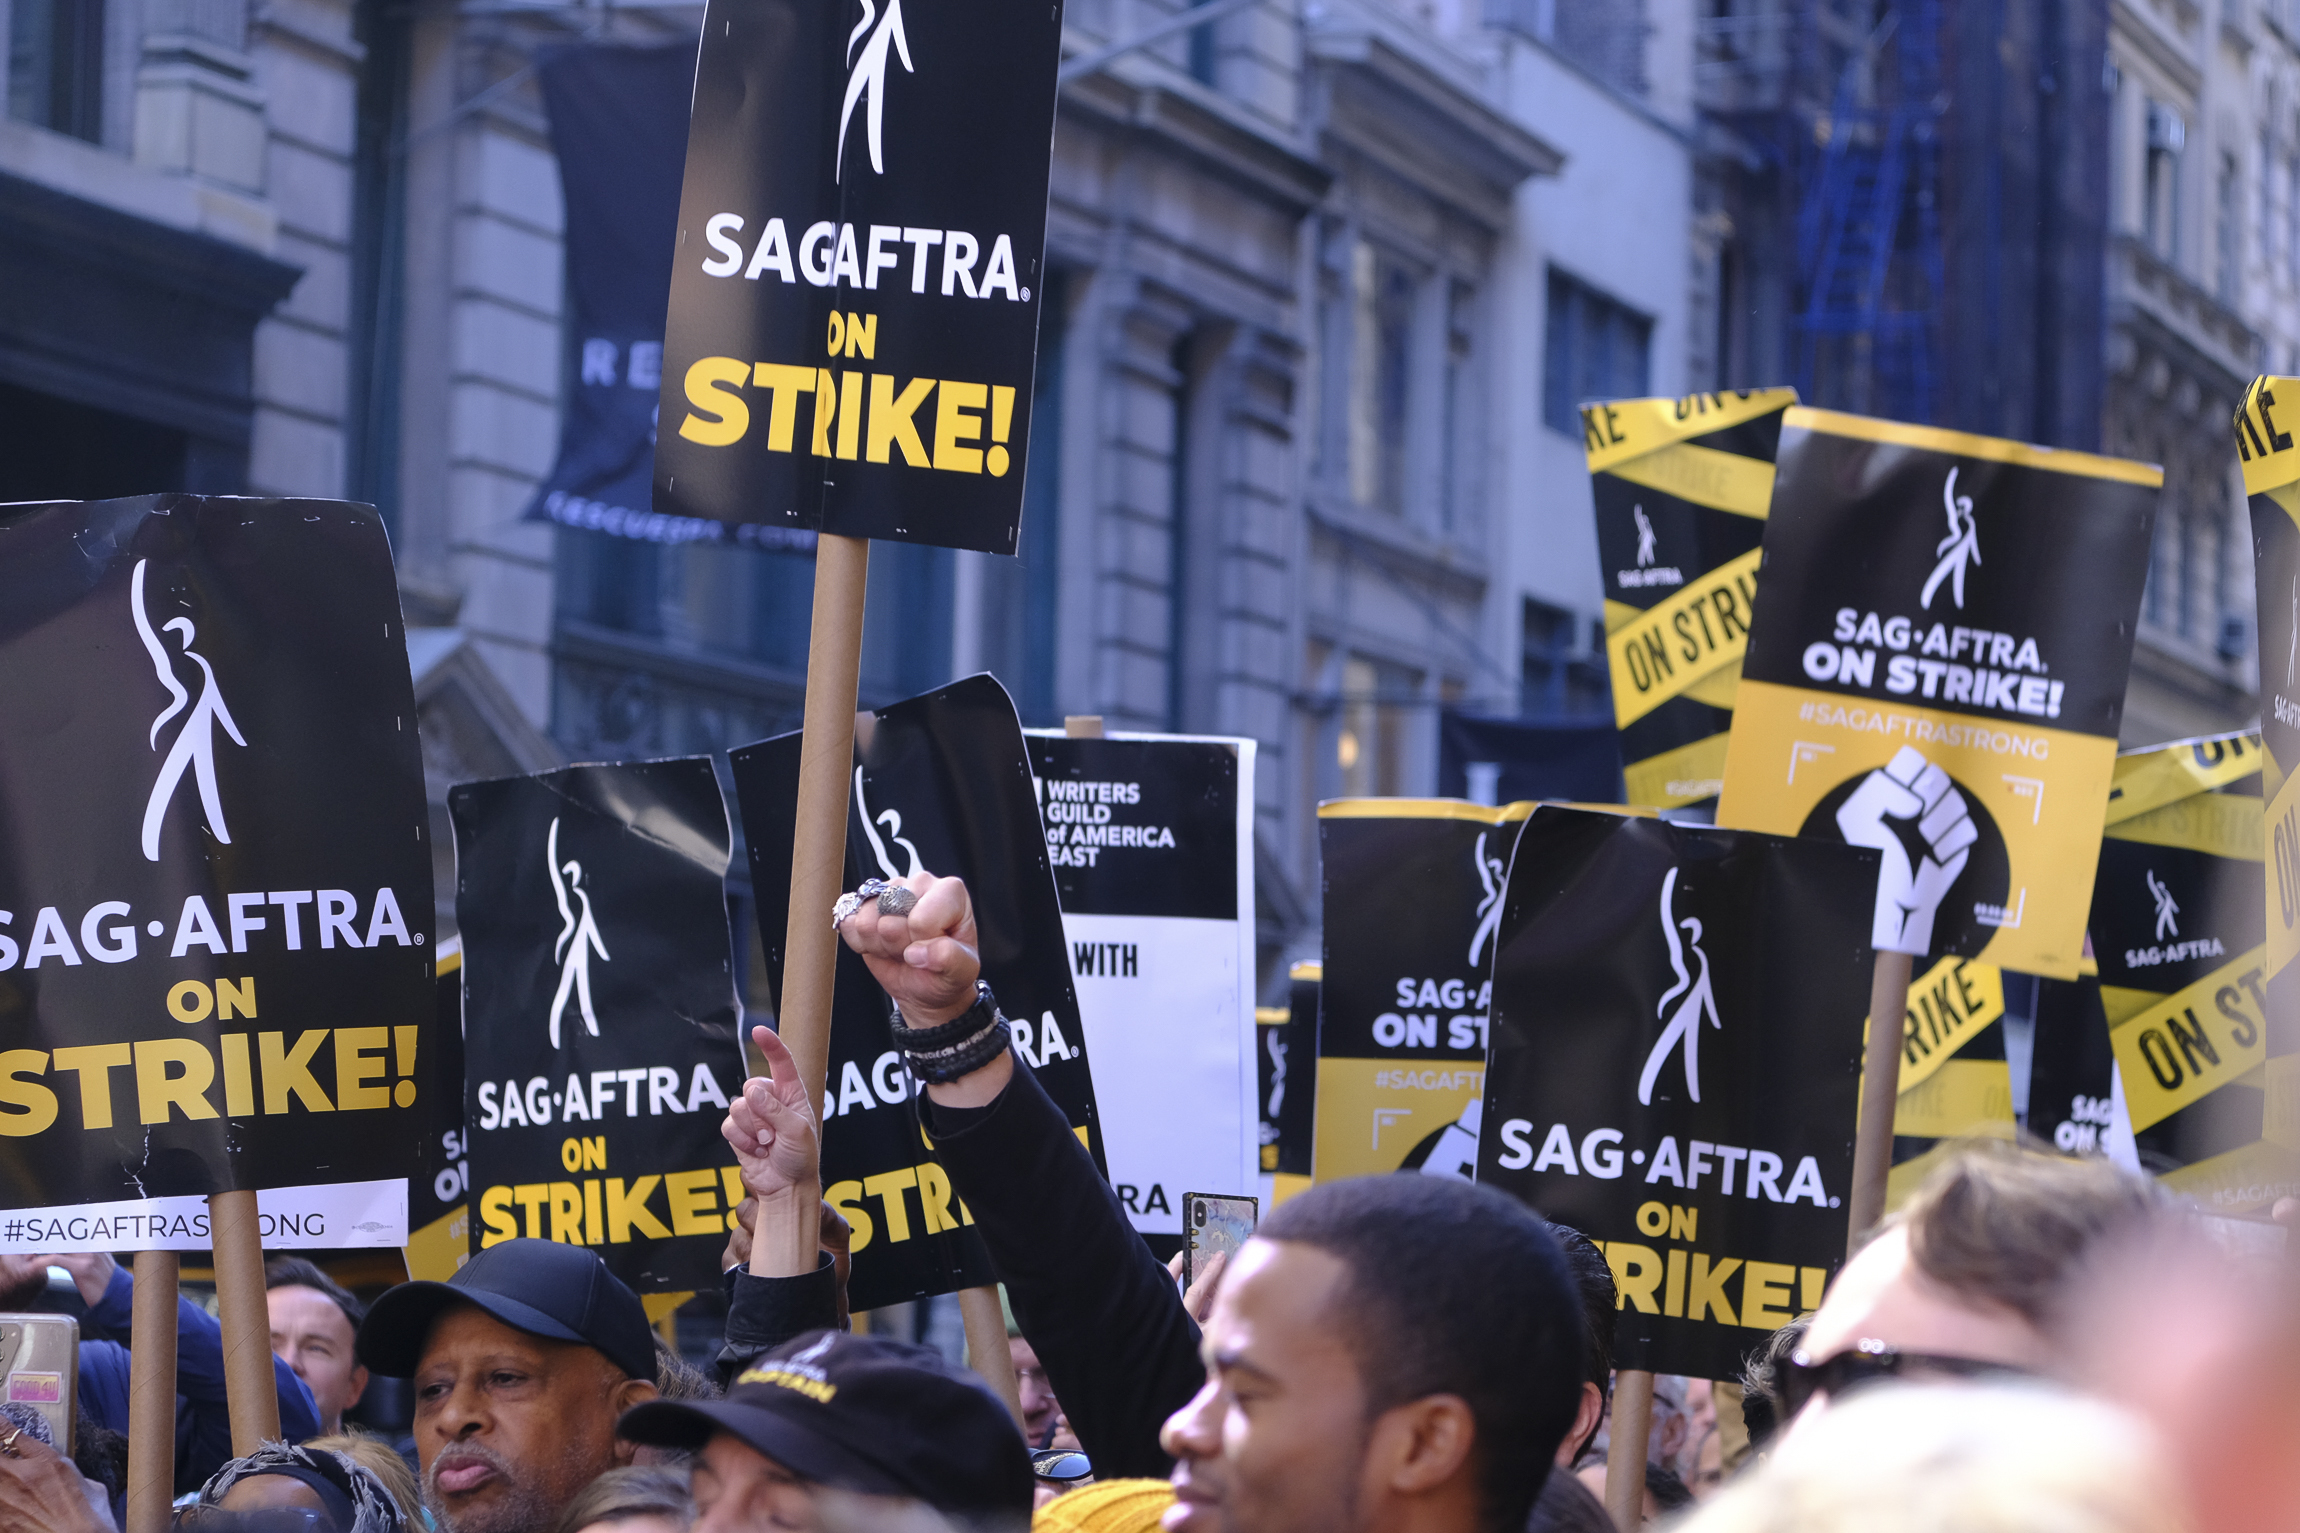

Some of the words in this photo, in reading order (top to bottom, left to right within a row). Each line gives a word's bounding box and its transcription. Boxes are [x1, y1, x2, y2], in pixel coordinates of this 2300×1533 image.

[827, 309, 877, 360] ON
[679, 356, 1016, 477] STRIKE!
[1624, 624, 1675, 693] ON
[1672, 571, 1757, 662] STRI
[1802, 641, 1876, 688] ON
[1884, 654, 2065, 719] STRIKE!
[1799, 702, 2050, 760] #SAGAFTRASTRONG
[1047, 779, 1141, 804] WRITERS
[1047, 801, 1112, 825] GUILD
[1047, 824, 1067, 844] of
[1070, 825, 1176, 848] AMERICA
[1049, 845, 1100, 868] EAST
[1073, 942, 1138, 977] WITH
[166, 976, 258, 1024] ON
[1371, 1012, 1438, 1048] ON
[2138, 1006, 2222, 1092] ON
[0, 1025, 419, 1137] STRIKE!
[561, 1136, 607, 1173] ON
[480, 1165, 747, 1250] STRIKE!
[1636, 1201, 1698, 1242] ON
